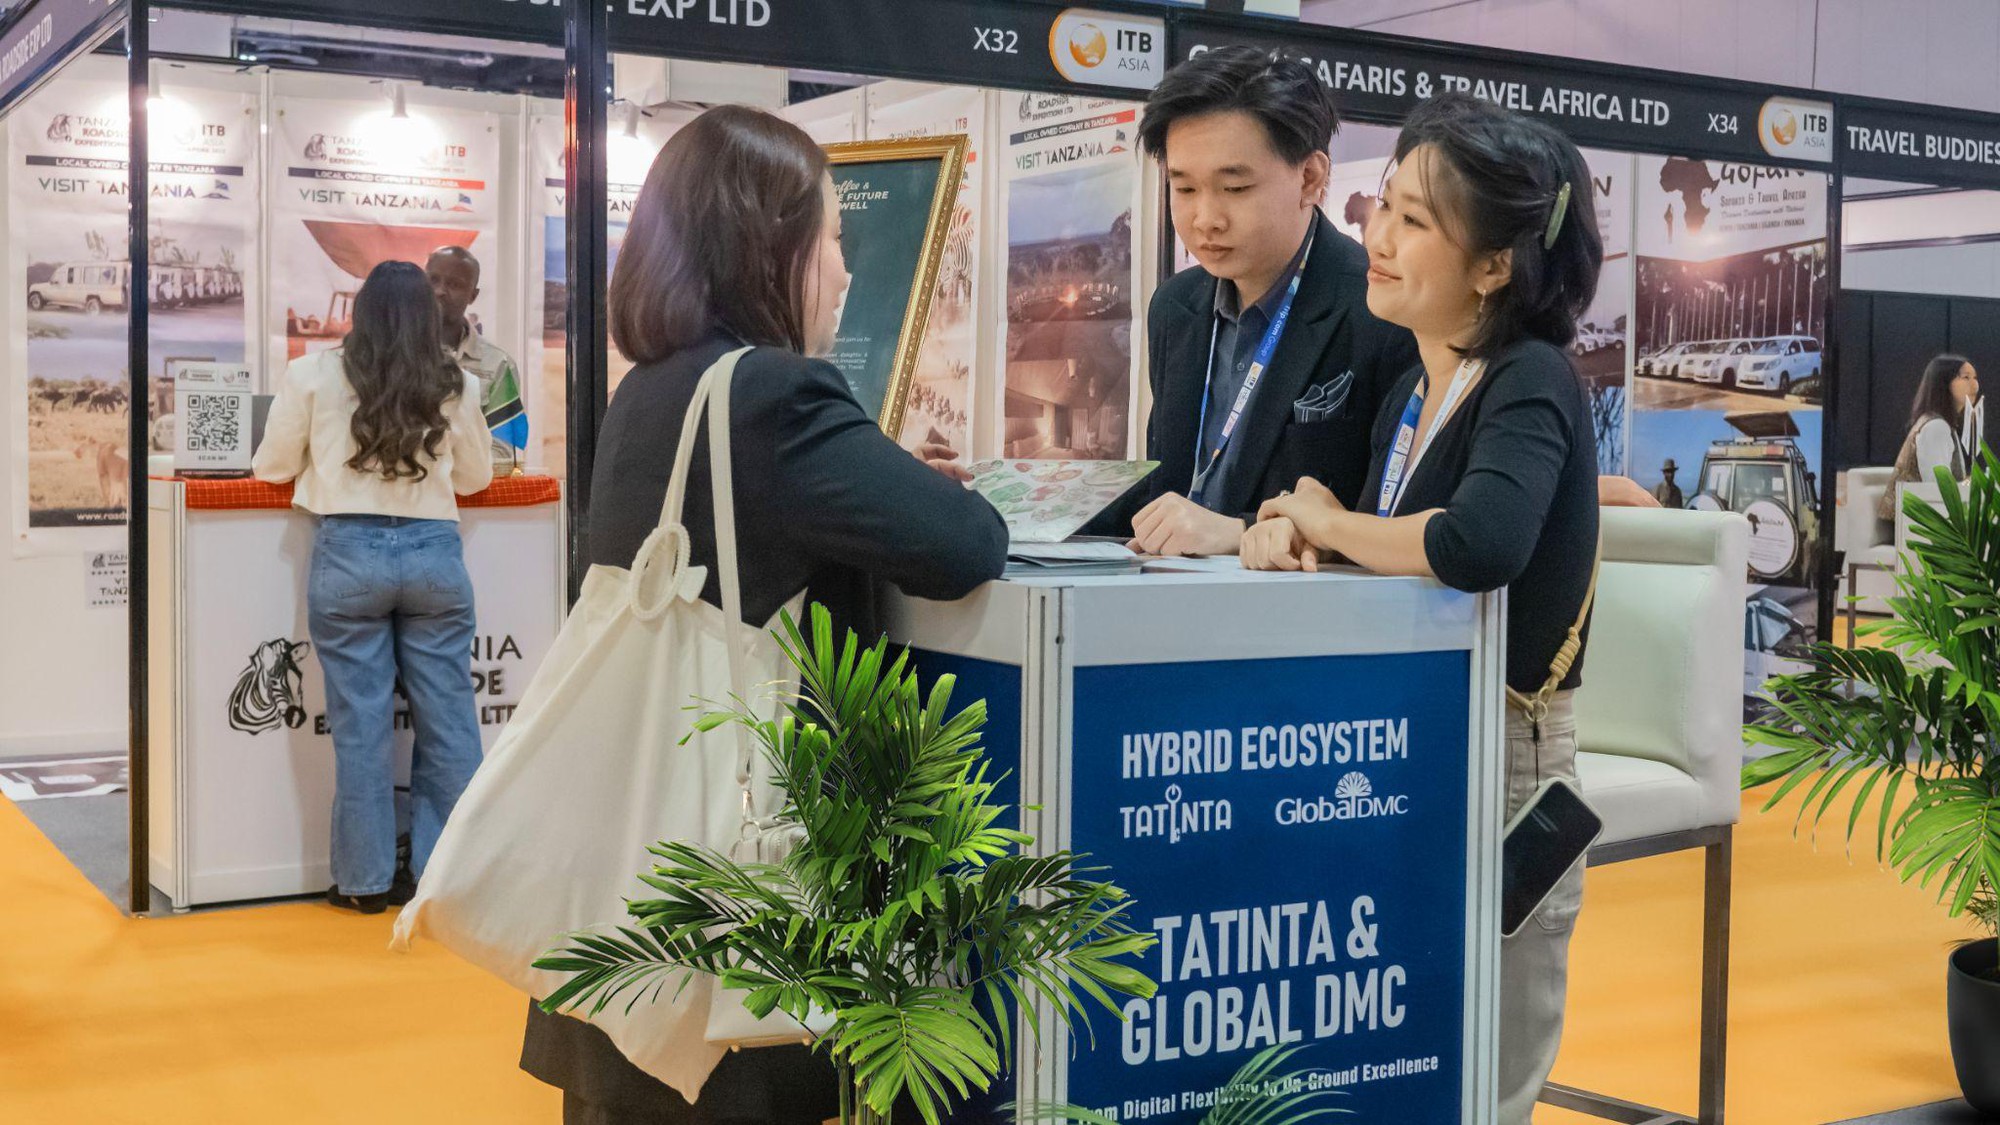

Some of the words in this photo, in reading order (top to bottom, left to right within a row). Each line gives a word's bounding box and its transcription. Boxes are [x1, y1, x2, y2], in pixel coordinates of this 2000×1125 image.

[973, 27, 1018, 54] X32
[1116, 29, 1152, 52] ITB
[1117, 57, 1149, 71] ASIA
[1301, 57, 1407, 97] AFARIS
[1414, 72, 1433, 99] &
[1539, 87, 1623, 121] AFRICA
[1630, 98, 1670, 126] LTD
[202, 124, 225, 137] ITB
[1707, 112, 1738, 135] X34
[1803, 114, 1827, 132] ITB
[1024, 131, 1040, 141] LOCAL
[1803, 136, 1825, 148] ASIA
[1846, 125, 1920, 157] TRAVEL
[445, 145, 466, 158] ITB
[1016, 151, 1042, 170] VISIT
[1045, 141, 1105, 165] TANZANIA
[55, 158, 88, 168] LOCAL
[315, 172, 343, 181] LOCAL
[39, 177, 90, 193] VISIT
[96, 180, 195, 199] TANANIA
[847, 190, 889, 201] FUTURE
[300, 188, 346, 204] VISIT
[350, 191, 443, 211] TANZANIA
[237, 370, 250, 379] ITB
[1122, 729, 1233, 779] HYBRID
[1240, 717, 1409, 771] ECOSYSTEM
[1153, 899, 1336, 984] TATINTA
[1346, 894, 1380, 960] &
[1121, 979, 1302, 1067] GLOBAL
[1314, 964, 1407, 1039] DMC
[1123, 1093, 1176, 1120] Digital
[1362, 1055, 1439, 1083] Excellence
